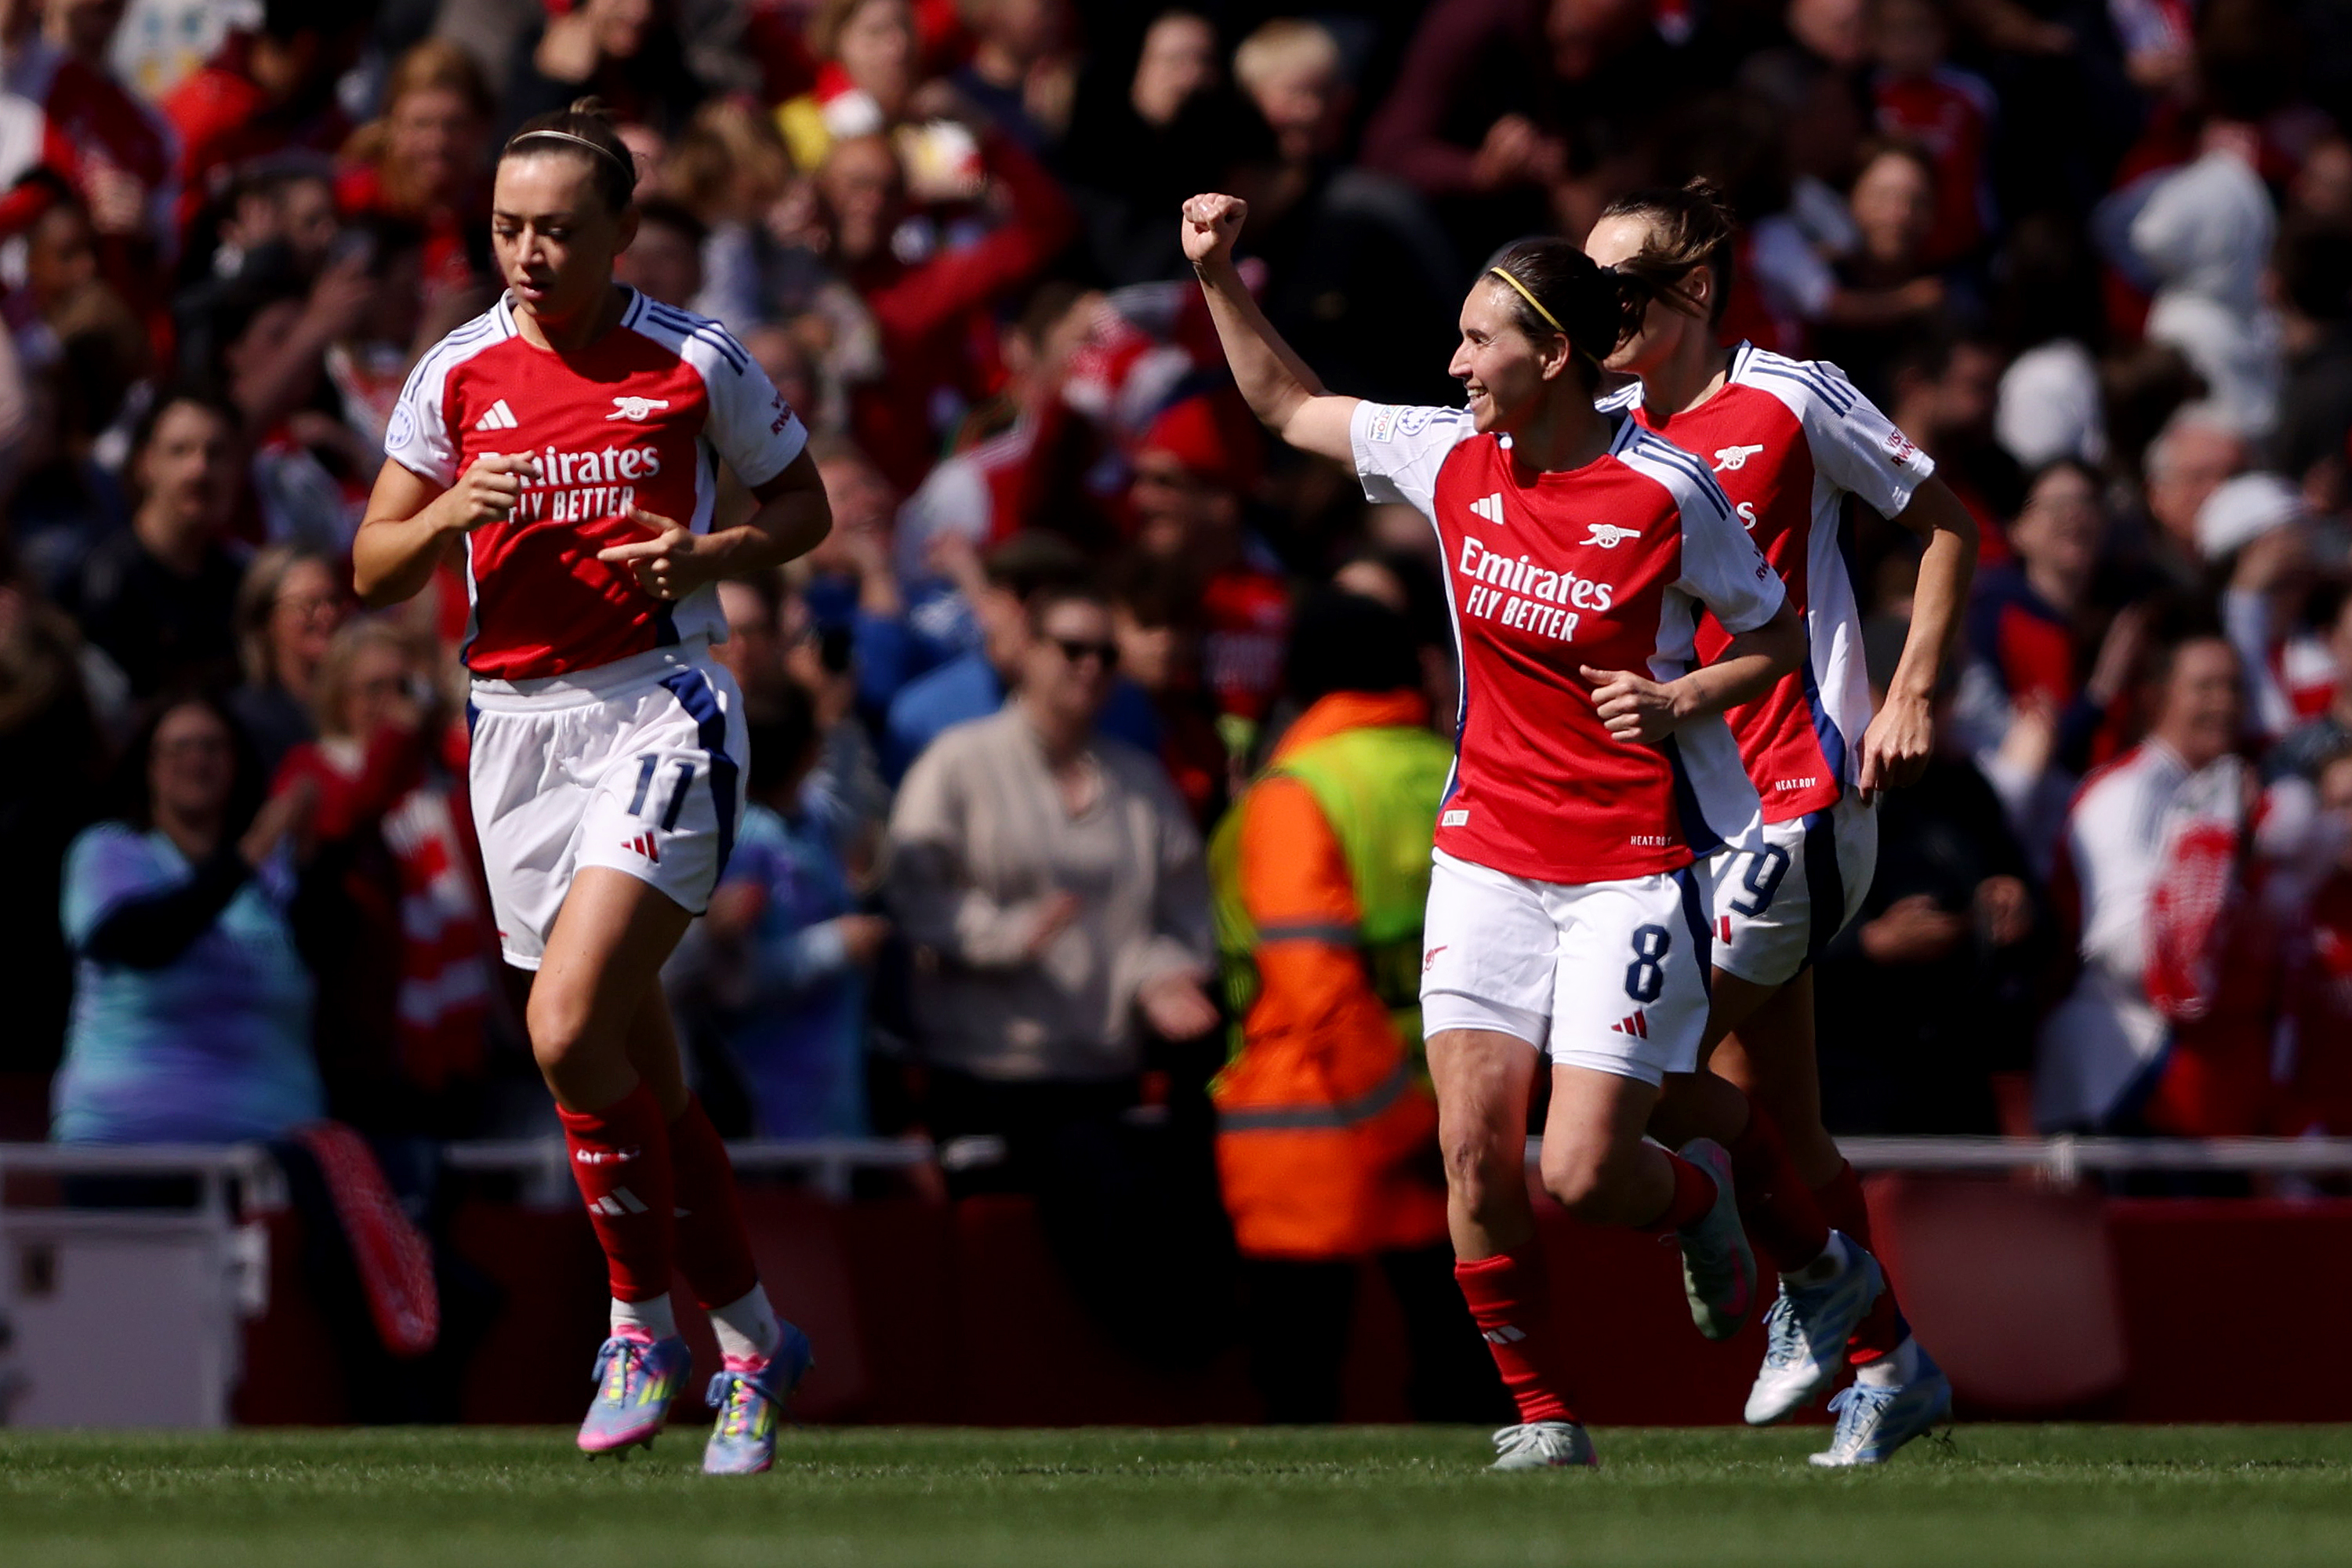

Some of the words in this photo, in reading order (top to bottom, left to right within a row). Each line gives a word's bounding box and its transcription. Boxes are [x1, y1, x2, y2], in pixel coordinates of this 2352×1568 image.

[478, 445, 661, 488] irates
[553, 485, 635, 522] BETTER
[1459, 535, 1613, 612] Emirates
[1466, 584, 1504, 620] FLY
[1501, 595, 1580, 642] BETTER
[1624, 923, 1671, 1004] 8
